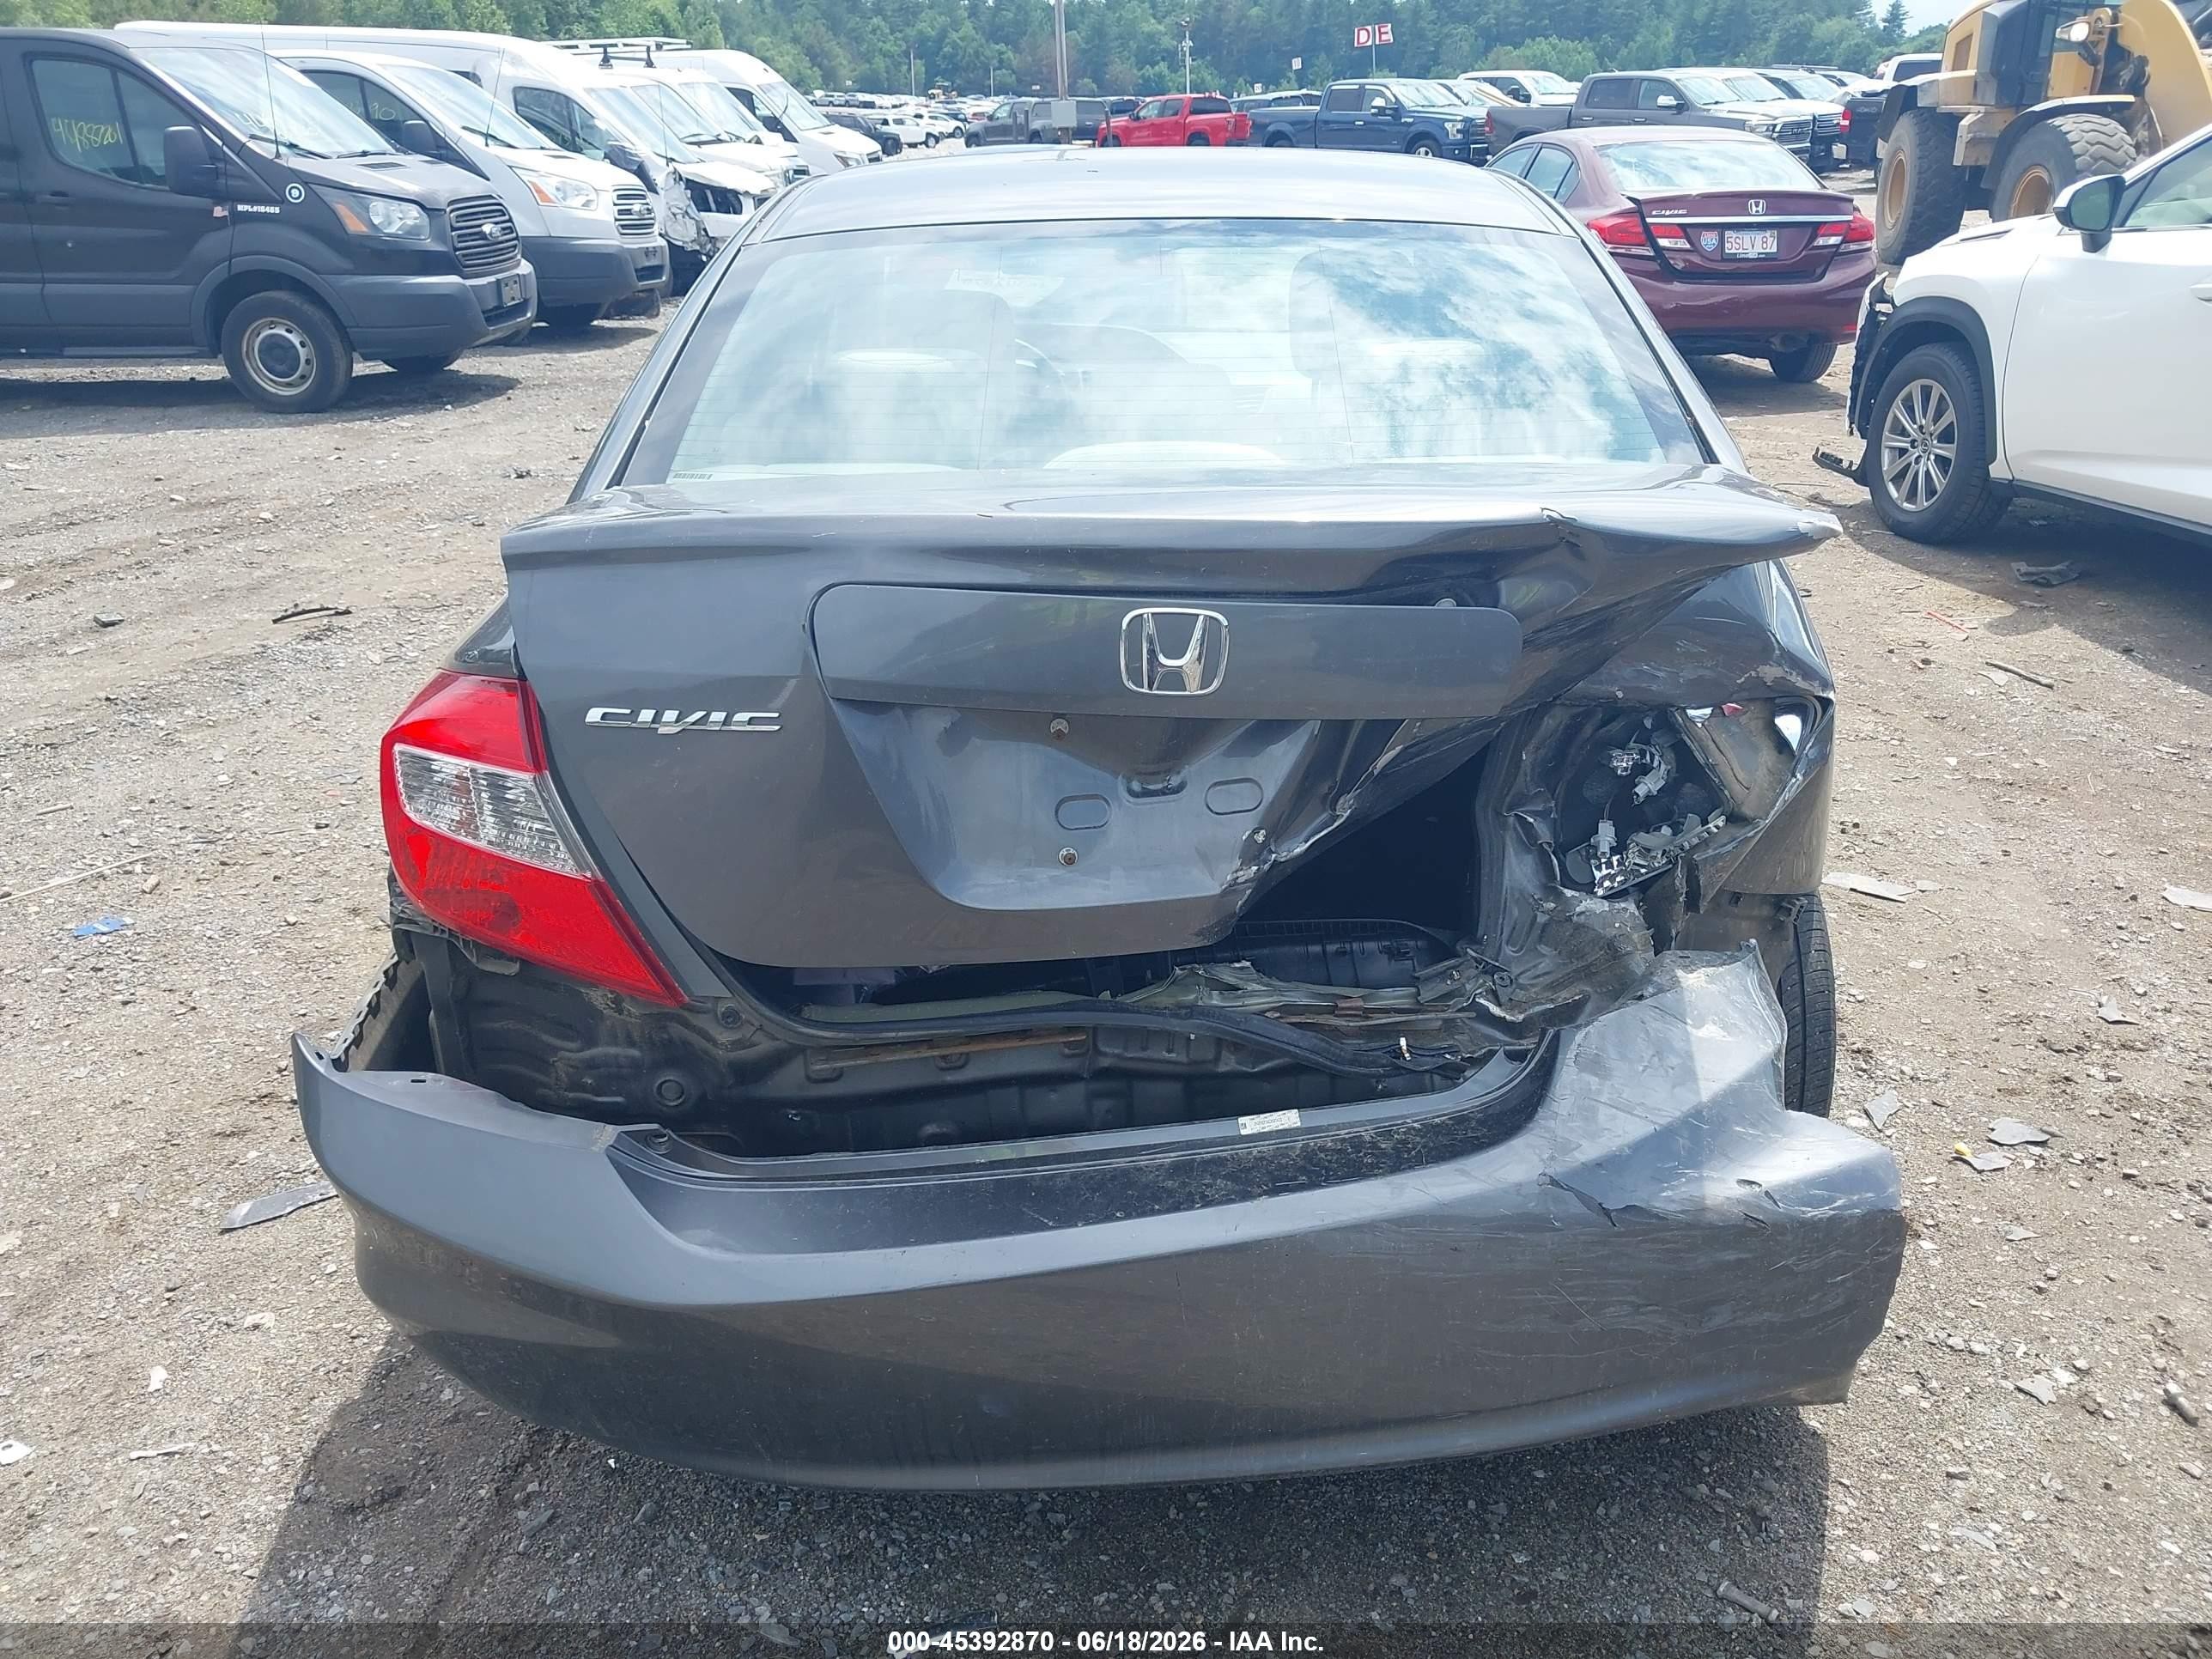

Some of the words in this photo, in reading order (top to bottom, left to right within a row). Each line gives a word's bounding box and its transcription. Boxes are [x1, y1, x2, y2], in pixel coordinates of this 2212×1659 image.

[1357, 27, 1371, 45] D
[1377, 25, 1391, 43] E
[1761, 235, 1776, 251] 87
[585, 707, 782, 734] CIVIC
